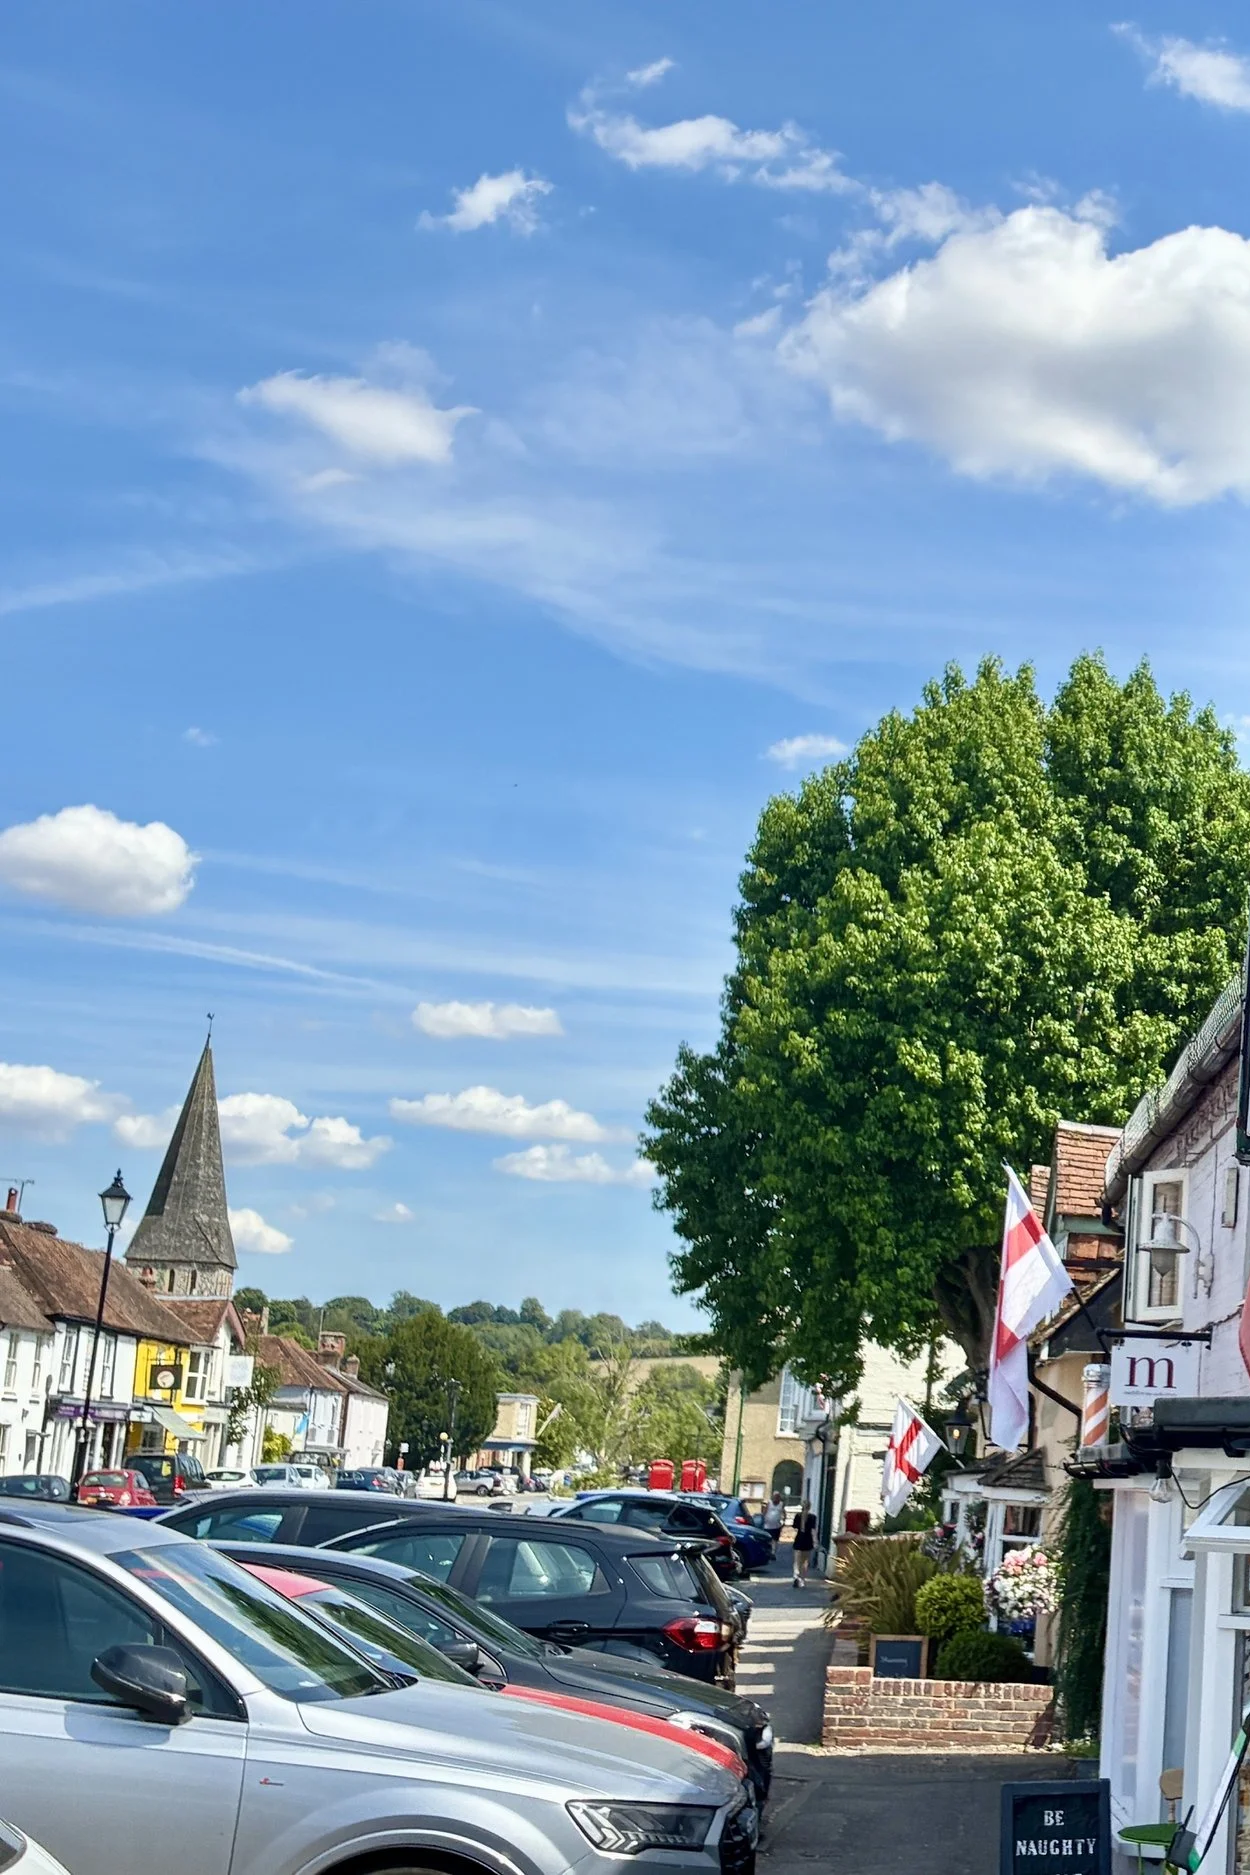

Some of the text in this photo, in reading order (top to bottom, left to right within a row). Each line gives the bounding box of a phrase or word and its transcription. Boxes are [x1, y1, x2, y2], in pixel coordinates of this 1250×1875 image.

[1124, 1356, 1177, 1389] m
[1043, 1810, 1065, 1826] BE
[1015, 1838, 1097, 1856] NAUGHTY
